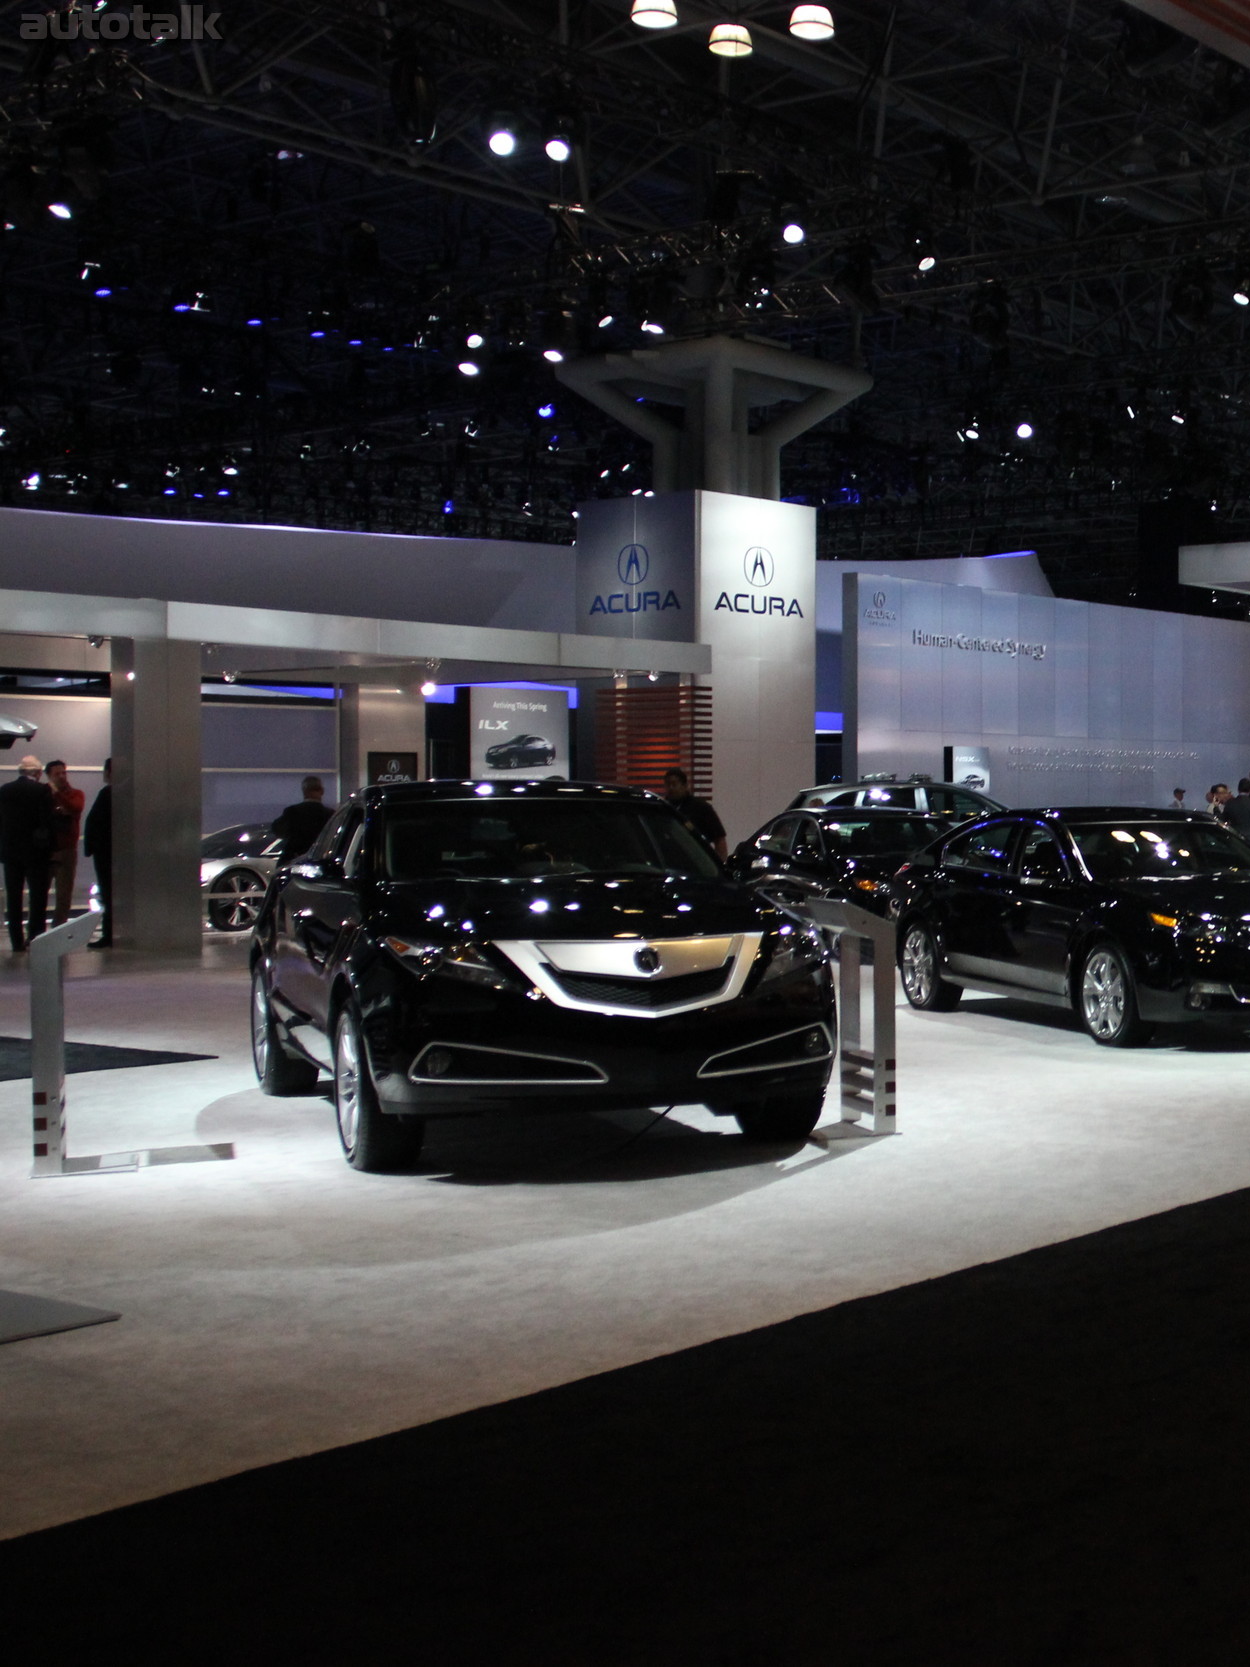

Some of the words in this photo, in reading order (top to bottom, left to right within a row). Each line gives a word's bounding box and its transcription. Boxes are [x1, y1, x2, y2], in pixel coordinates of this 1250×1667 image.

[589, 590, 681, 615] ACURA
[714, 592, 804, 618] ACURA
[864, 608, 897, 621] ACURA
[1005, 638, 1047, 661] Synergy
[516, 702, 528, 710] This
[528, 702, 548, 713] Spring
[478, 719, 509, 731] ILX
[377, 774, 412, 783] ACURA
